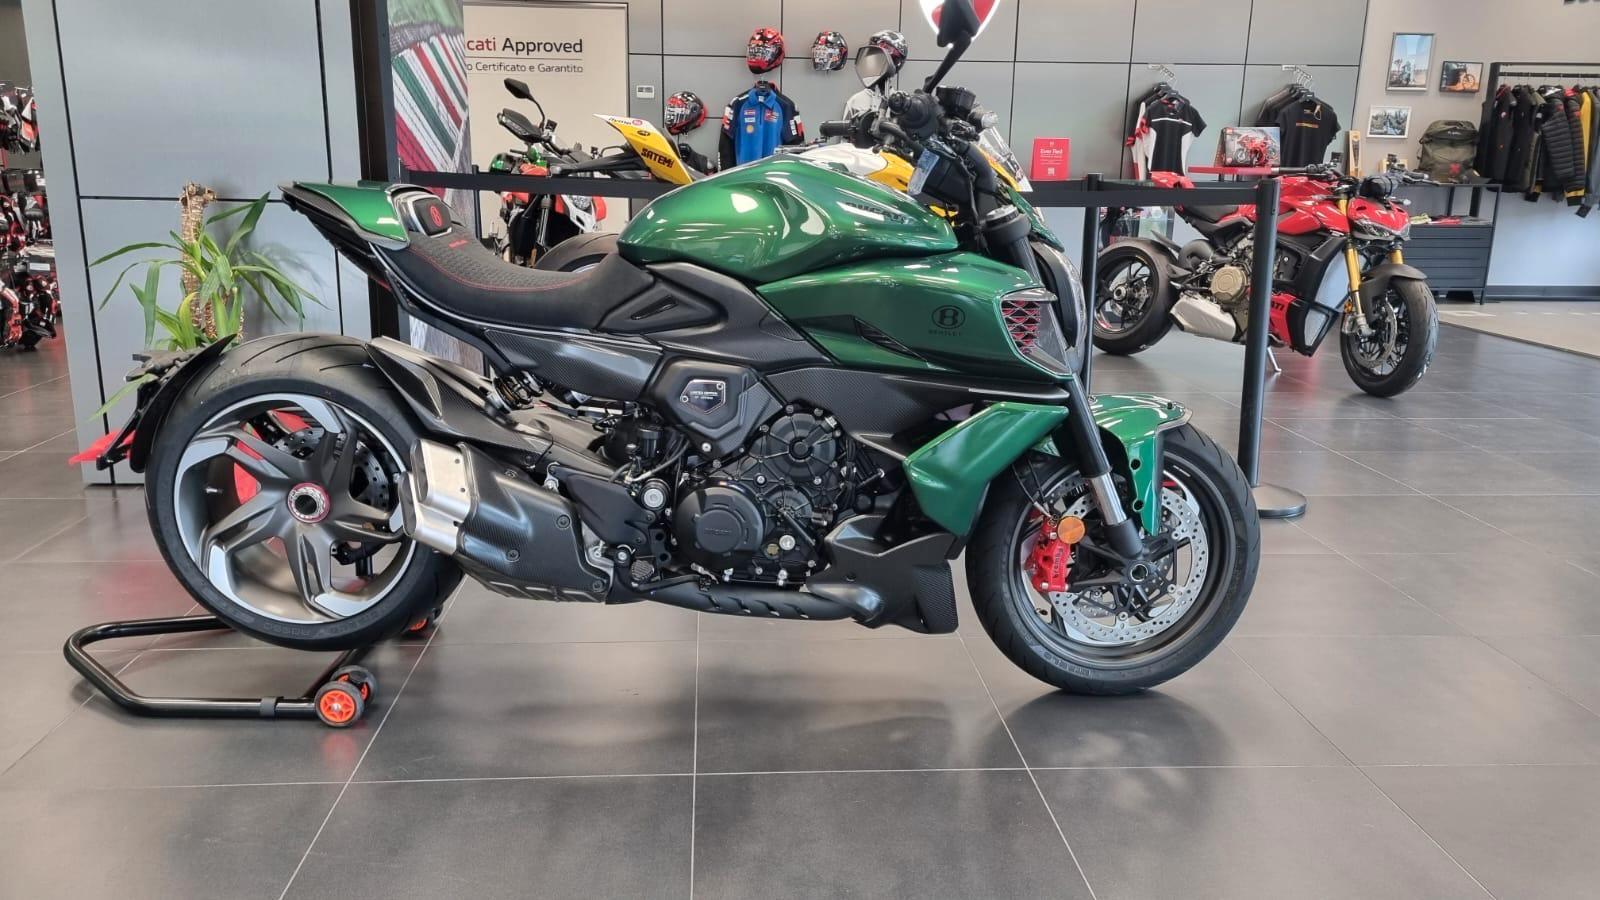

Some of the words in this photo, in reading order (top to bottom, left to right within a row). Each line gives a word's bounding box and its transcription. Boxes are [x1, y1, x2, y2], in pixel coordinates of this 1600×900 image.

[465, 37, 497, 51] cati
[502, 37, 583, 55] Approved
[475, 61, 527, 72] Certificato
[537, 63, 583, 73] Garantito
